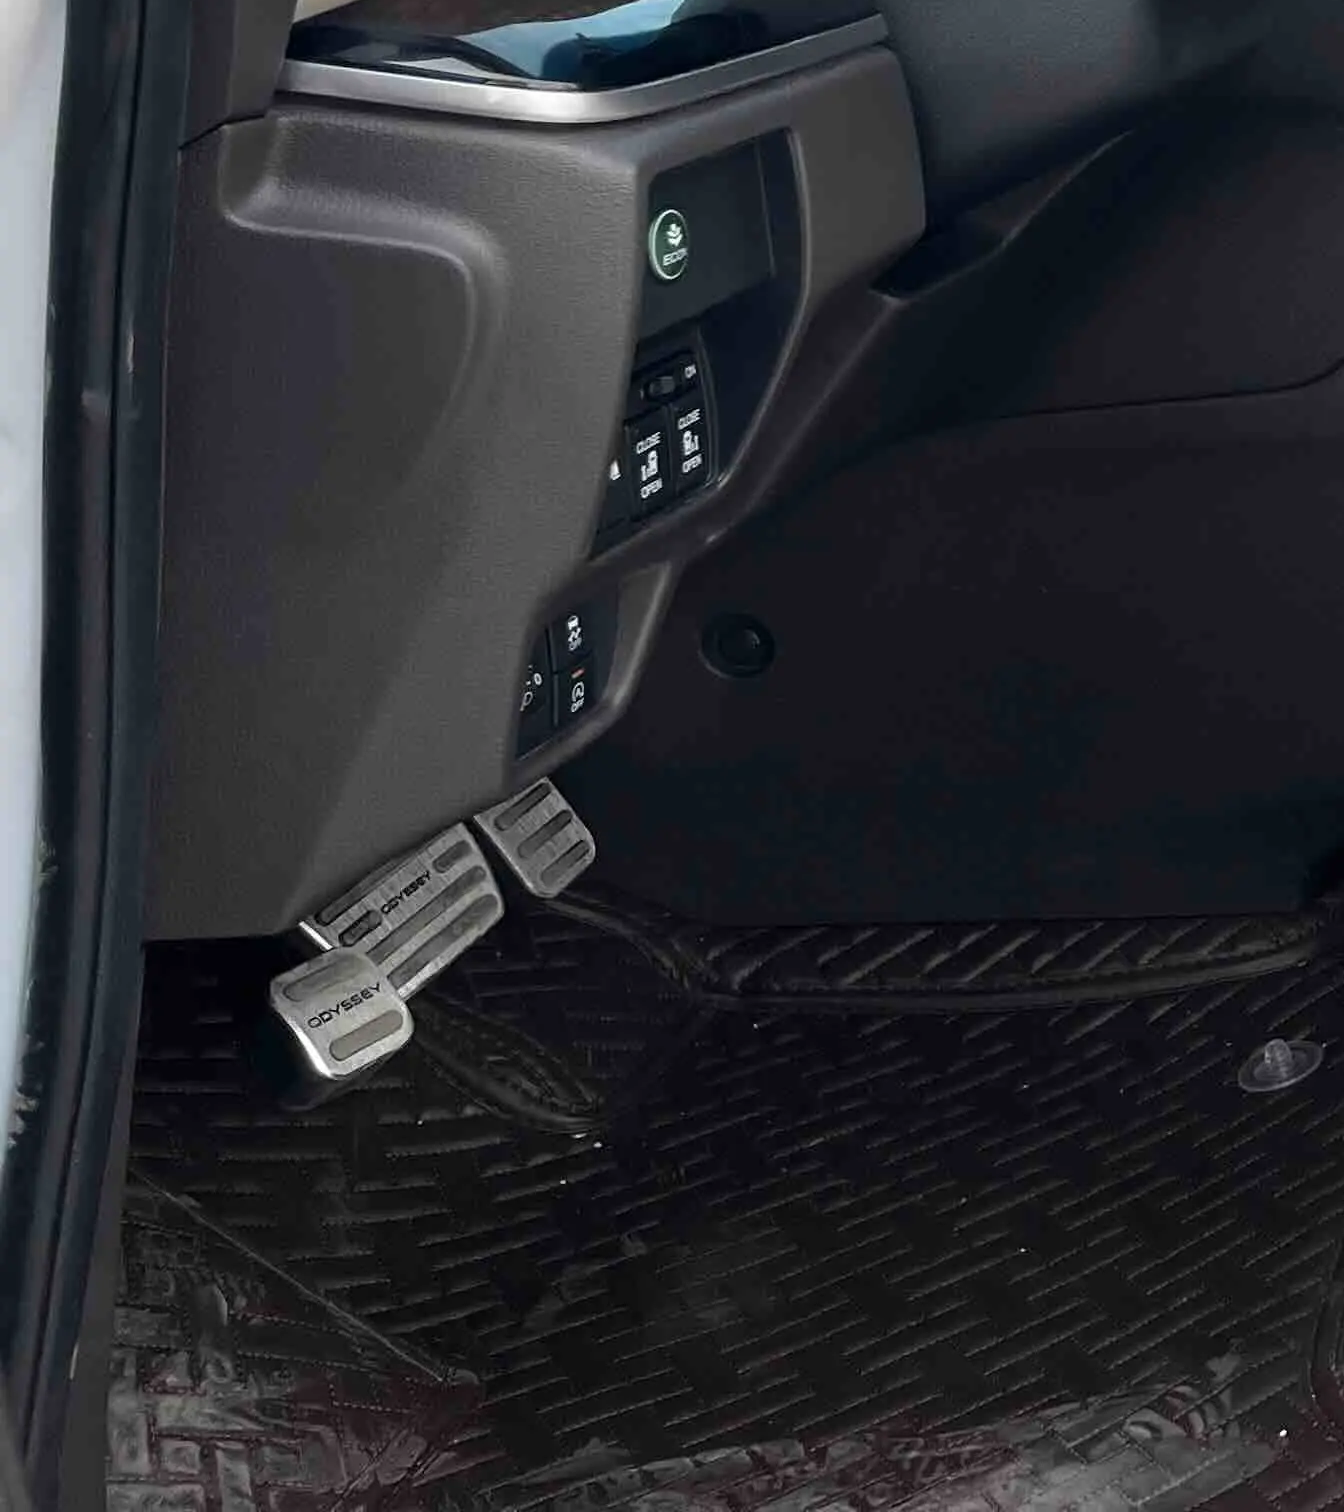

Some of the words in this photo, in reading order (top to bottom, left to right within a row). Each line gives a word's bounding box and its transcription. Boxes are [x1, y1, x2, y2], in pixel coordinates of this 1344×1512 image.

[678, 408, 701, 430] CLOSE
[636, 431, 661, 455] CLOSE
[682, 453, 702, 474] OPEN
[640, 477, 663, 499] OPEN
[380, 870, 431, 915] ODYSSEY
[307, 981, 380, 1029] ODYSSEY
